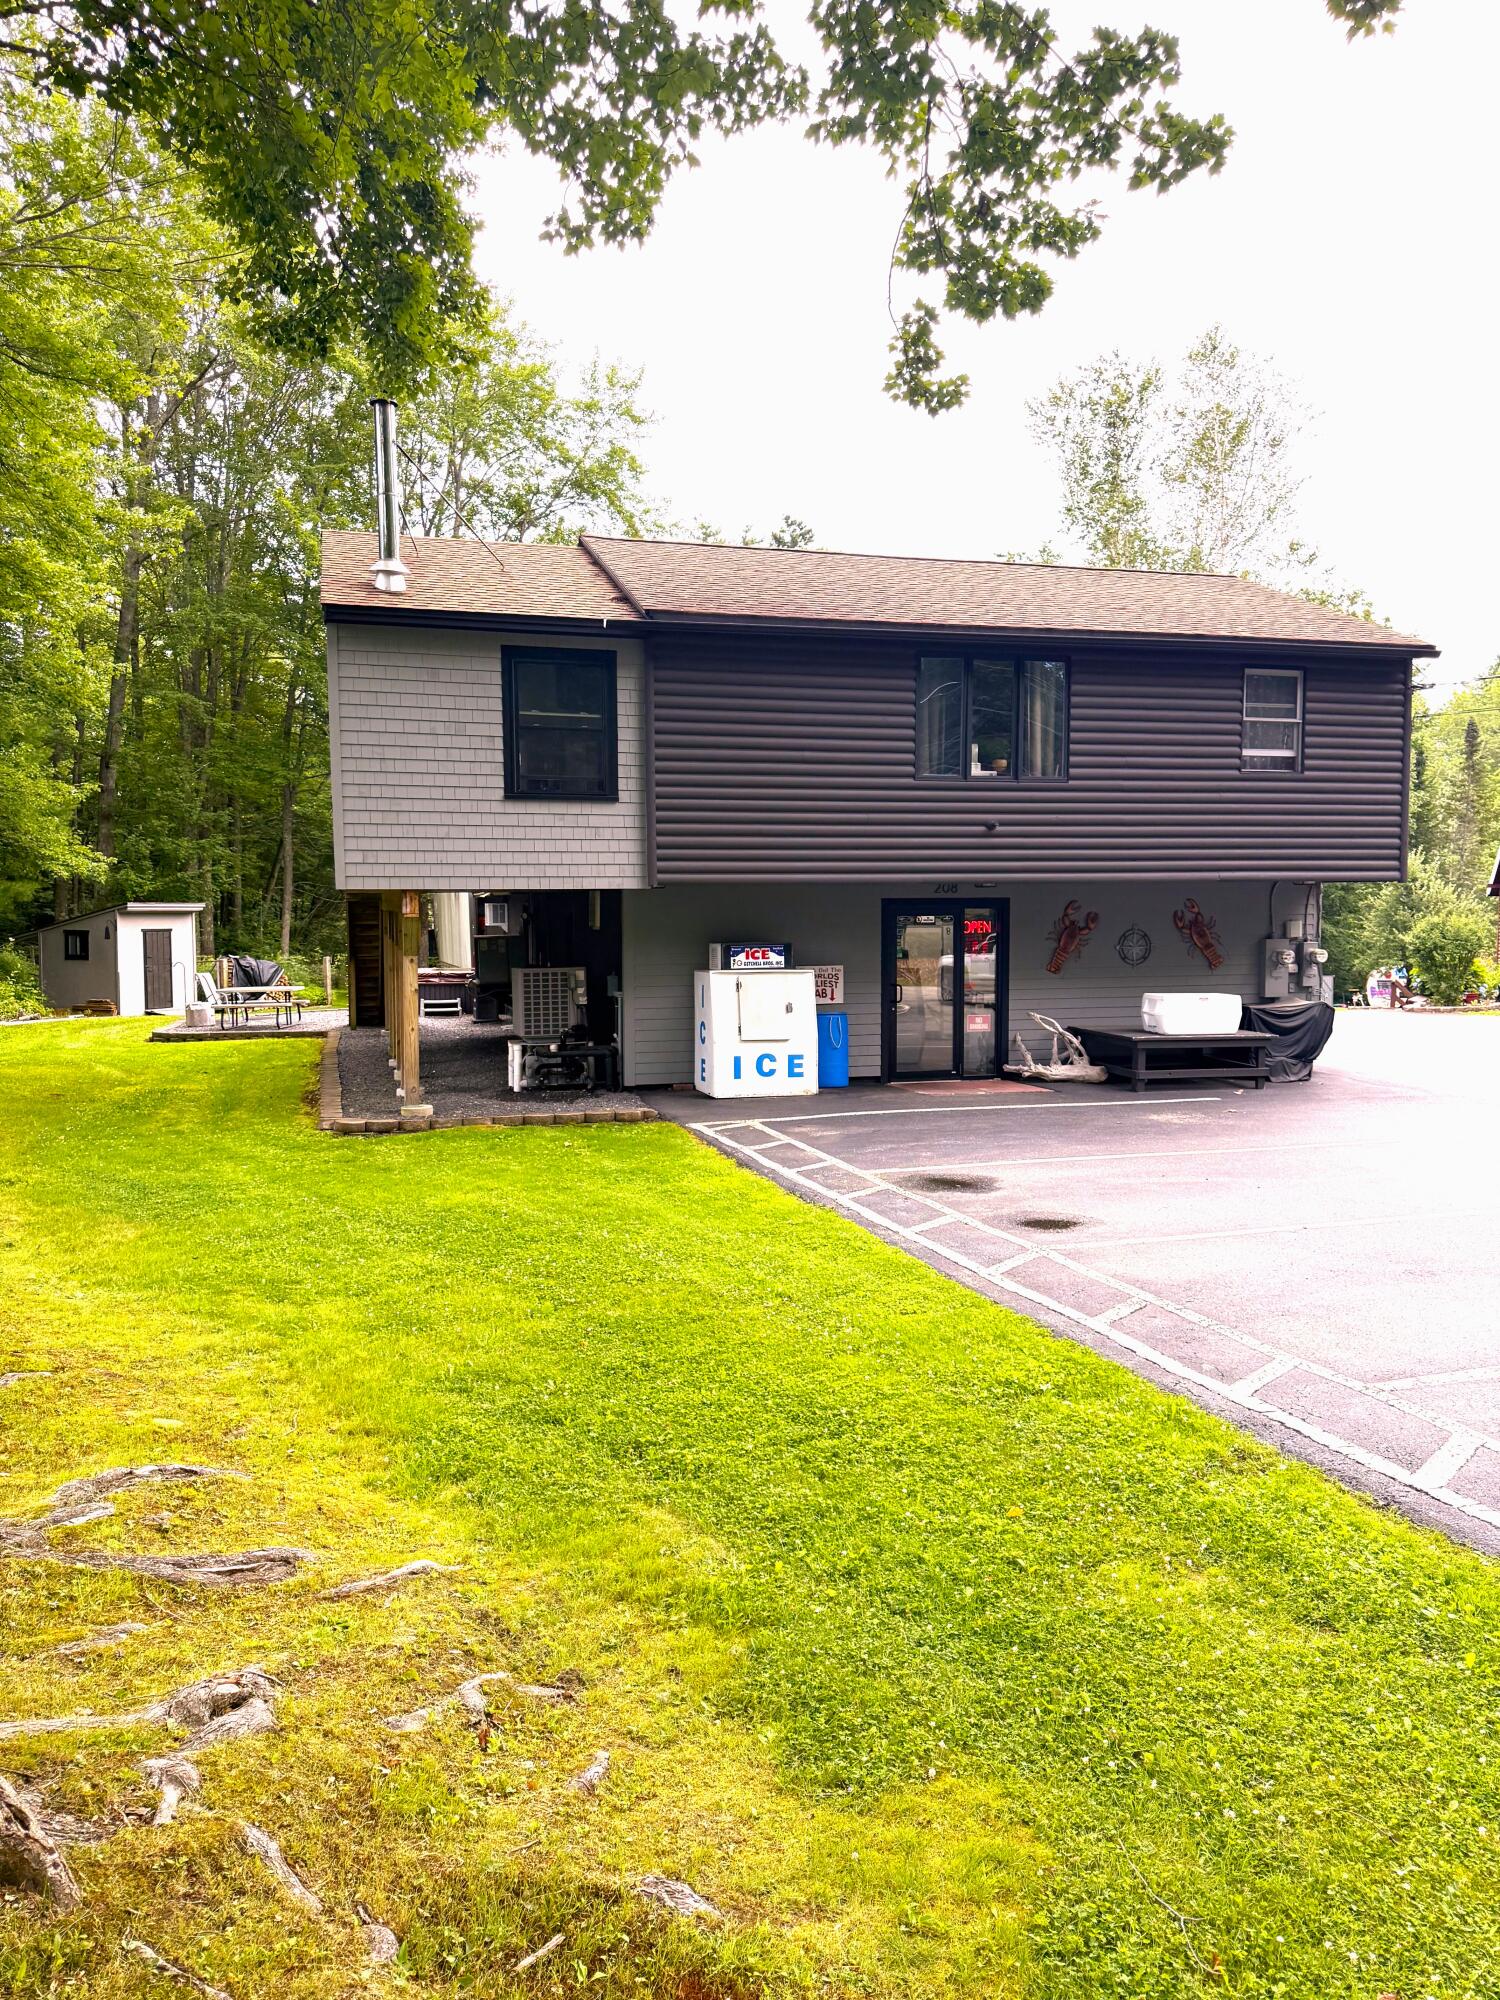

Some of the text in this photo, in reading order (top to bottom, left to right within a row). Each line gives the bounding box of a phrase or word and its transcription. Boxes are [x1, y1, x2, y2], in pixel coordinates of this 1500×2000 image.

[934, 882, 958, 894] 208
[963, 920, 992, 934] OPEN
[745, 947, 770, 960] ICE
[815, 980, 839, 988] LIEST
[734, 1053, 804, 1080] ICE
